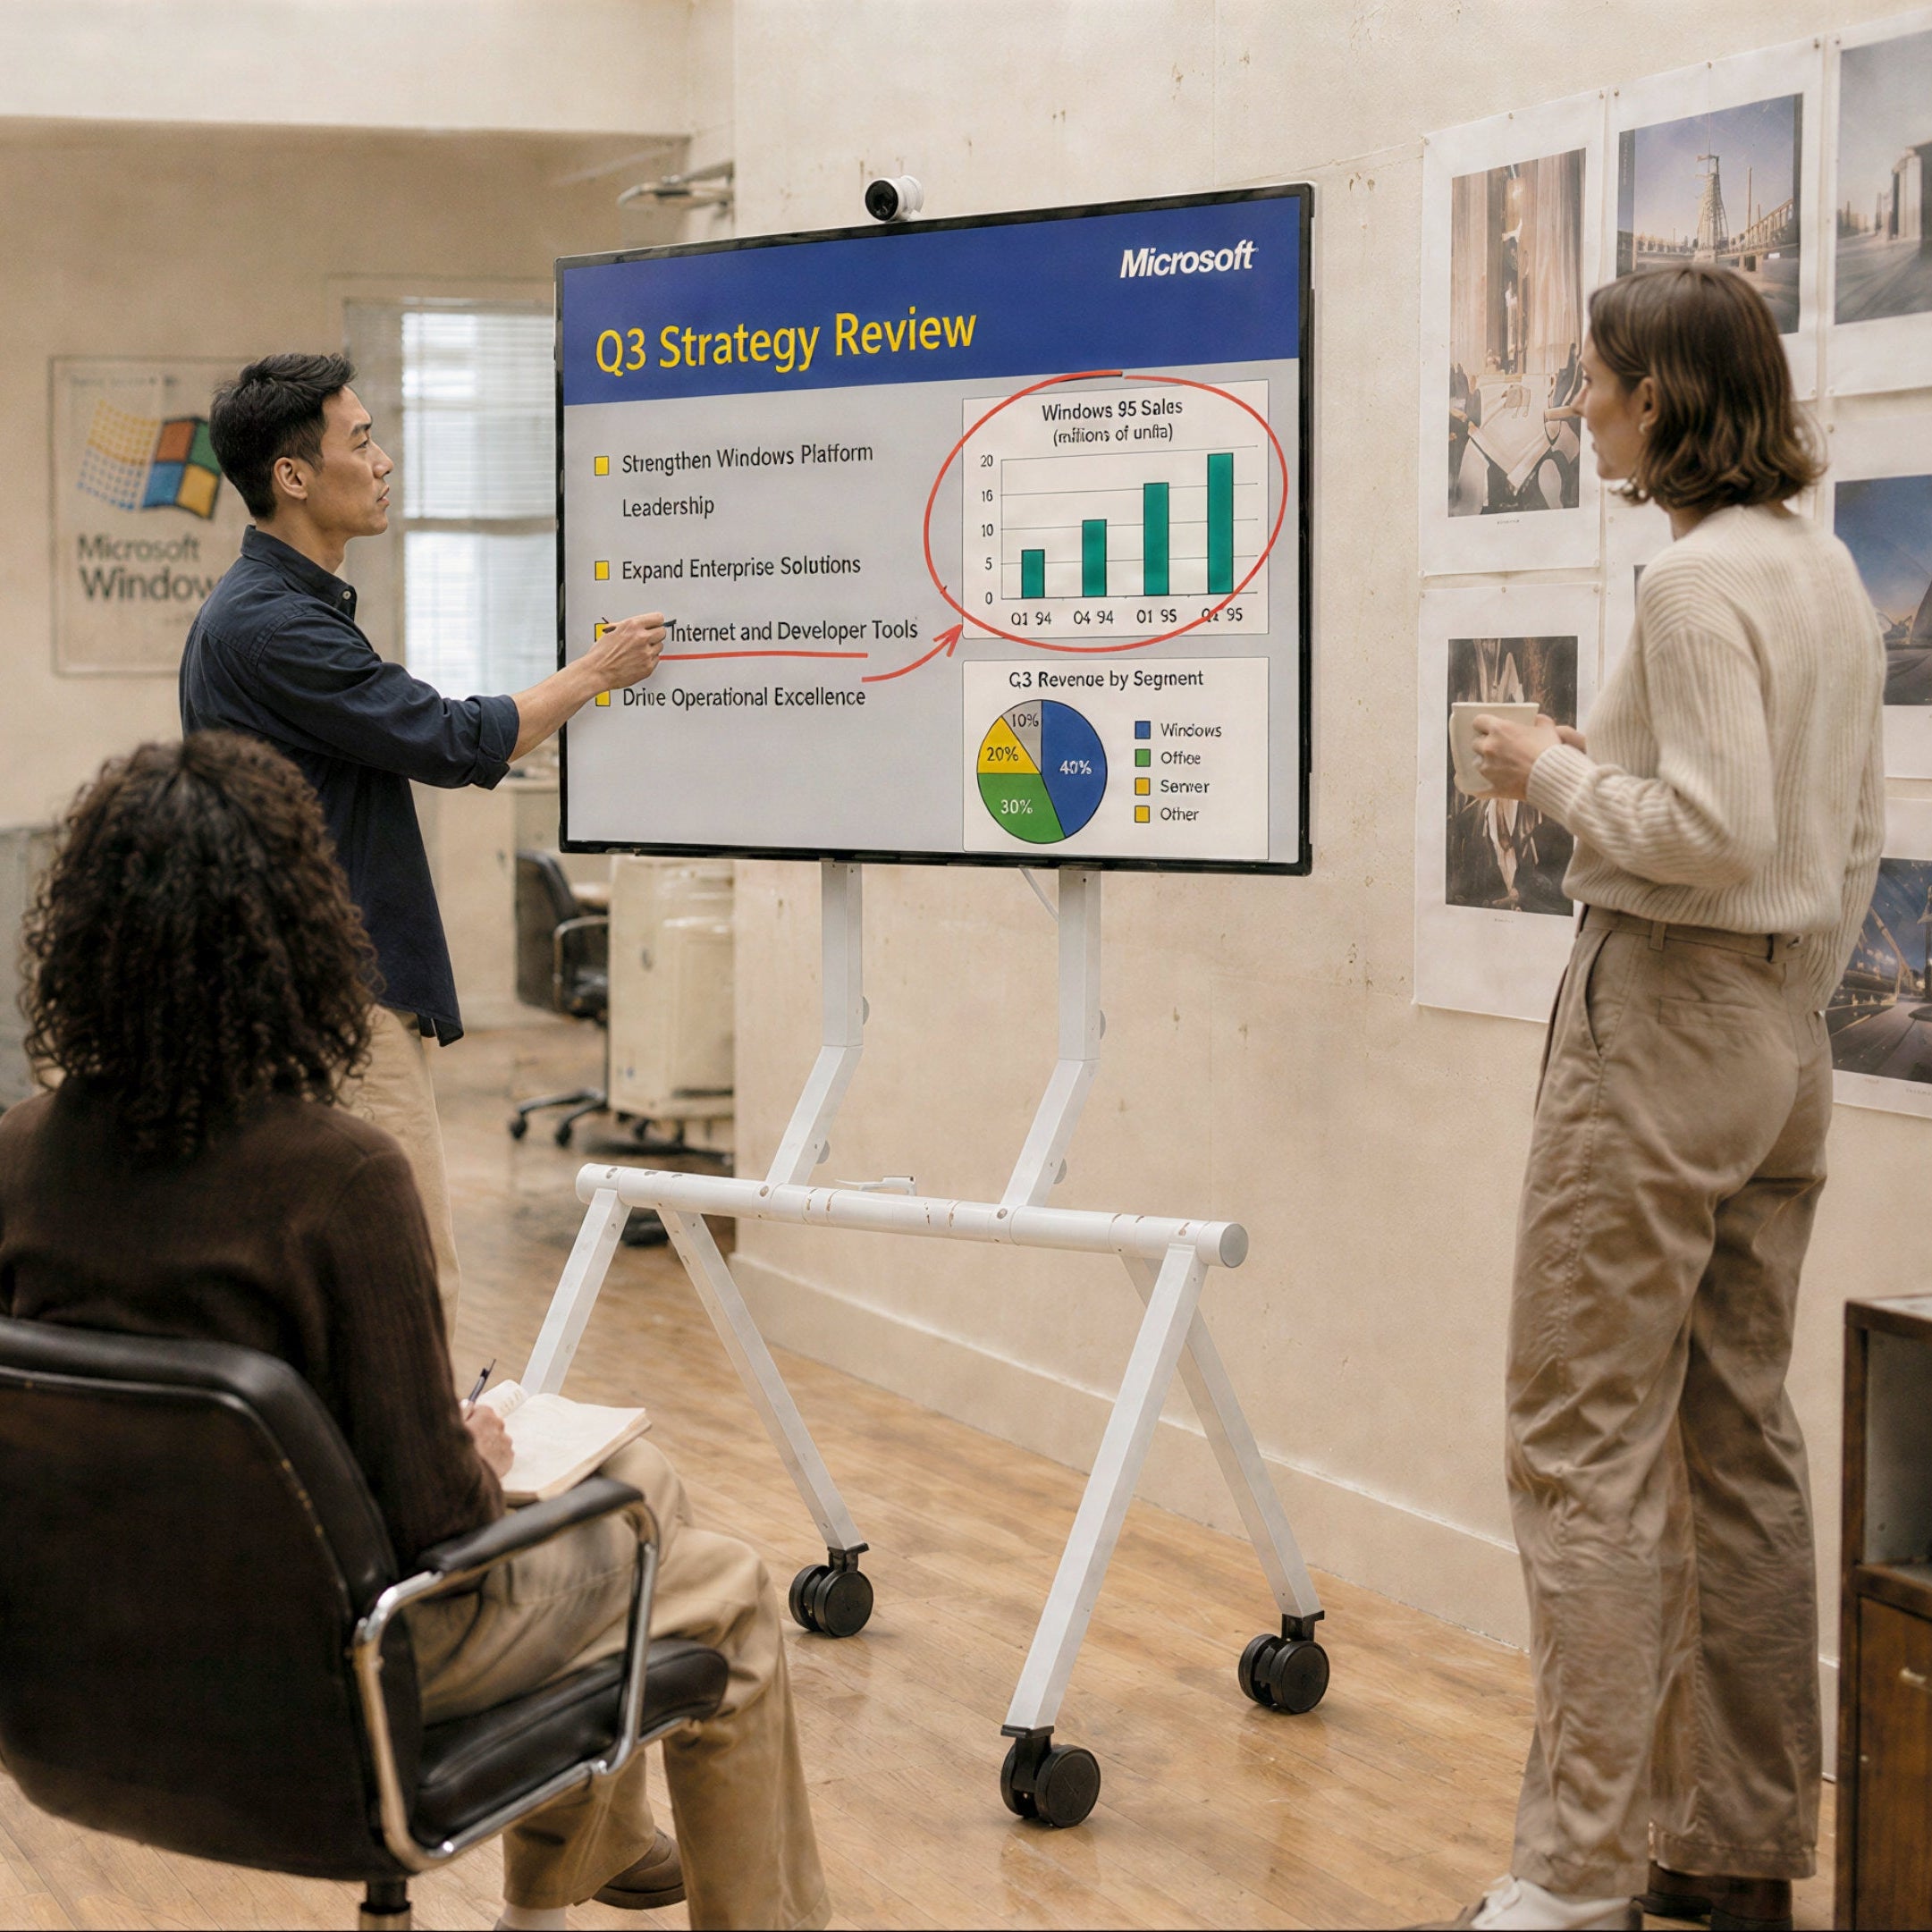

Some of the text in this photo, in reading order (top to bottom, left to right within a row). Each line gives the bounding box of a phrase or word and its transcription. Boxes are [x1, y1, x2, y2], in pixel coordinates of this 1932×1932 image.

[1119, 239, 1254, 279] Microsoft
[595, 306, 977, 377] Q3 Strategy Review
[1042, 397, 1183, 422] Windows 95 Sales
[621, 451, 712, 477] Strengthen
[716, 446, 795, 468] Windows
[980, 454, 994, 468] 20
[622, 495, 715, 520] Leadership
[981, 523, 994, 537] 10
[77, 533, 200, 561] Microsoft
[622, 554, 861, 585] Expand Enterprise Solutions
[984, 556, 992, 571] 5
[78, 565, 220, 603] Window
[984, 591, 993, 605] 0
[1034, 611, 1052, 626] 94
[1096, 610, 1114, 625] 94
[1160, 608, 1177, 623] 95
[1226, 607, 1244, 622] 95
[671, 619, 918, 645] Internet and Developer Tools
[1038, 671, 1105, 688] Revenue
[1109, 670, 1129, 692] by
[1133, 670, 1204, 691] Segment
[671, 686, 768, 712] Operational
[774, 686, 866, 706] Excellence
[1160, 722, 1222, 738] Windows
[986, 746, 1019, 762] 20%
[1059, 760, 1093, 775] 40%
[1000, 798, 1033, 814] 30%
[1160, 806, 1200, 822] Other
